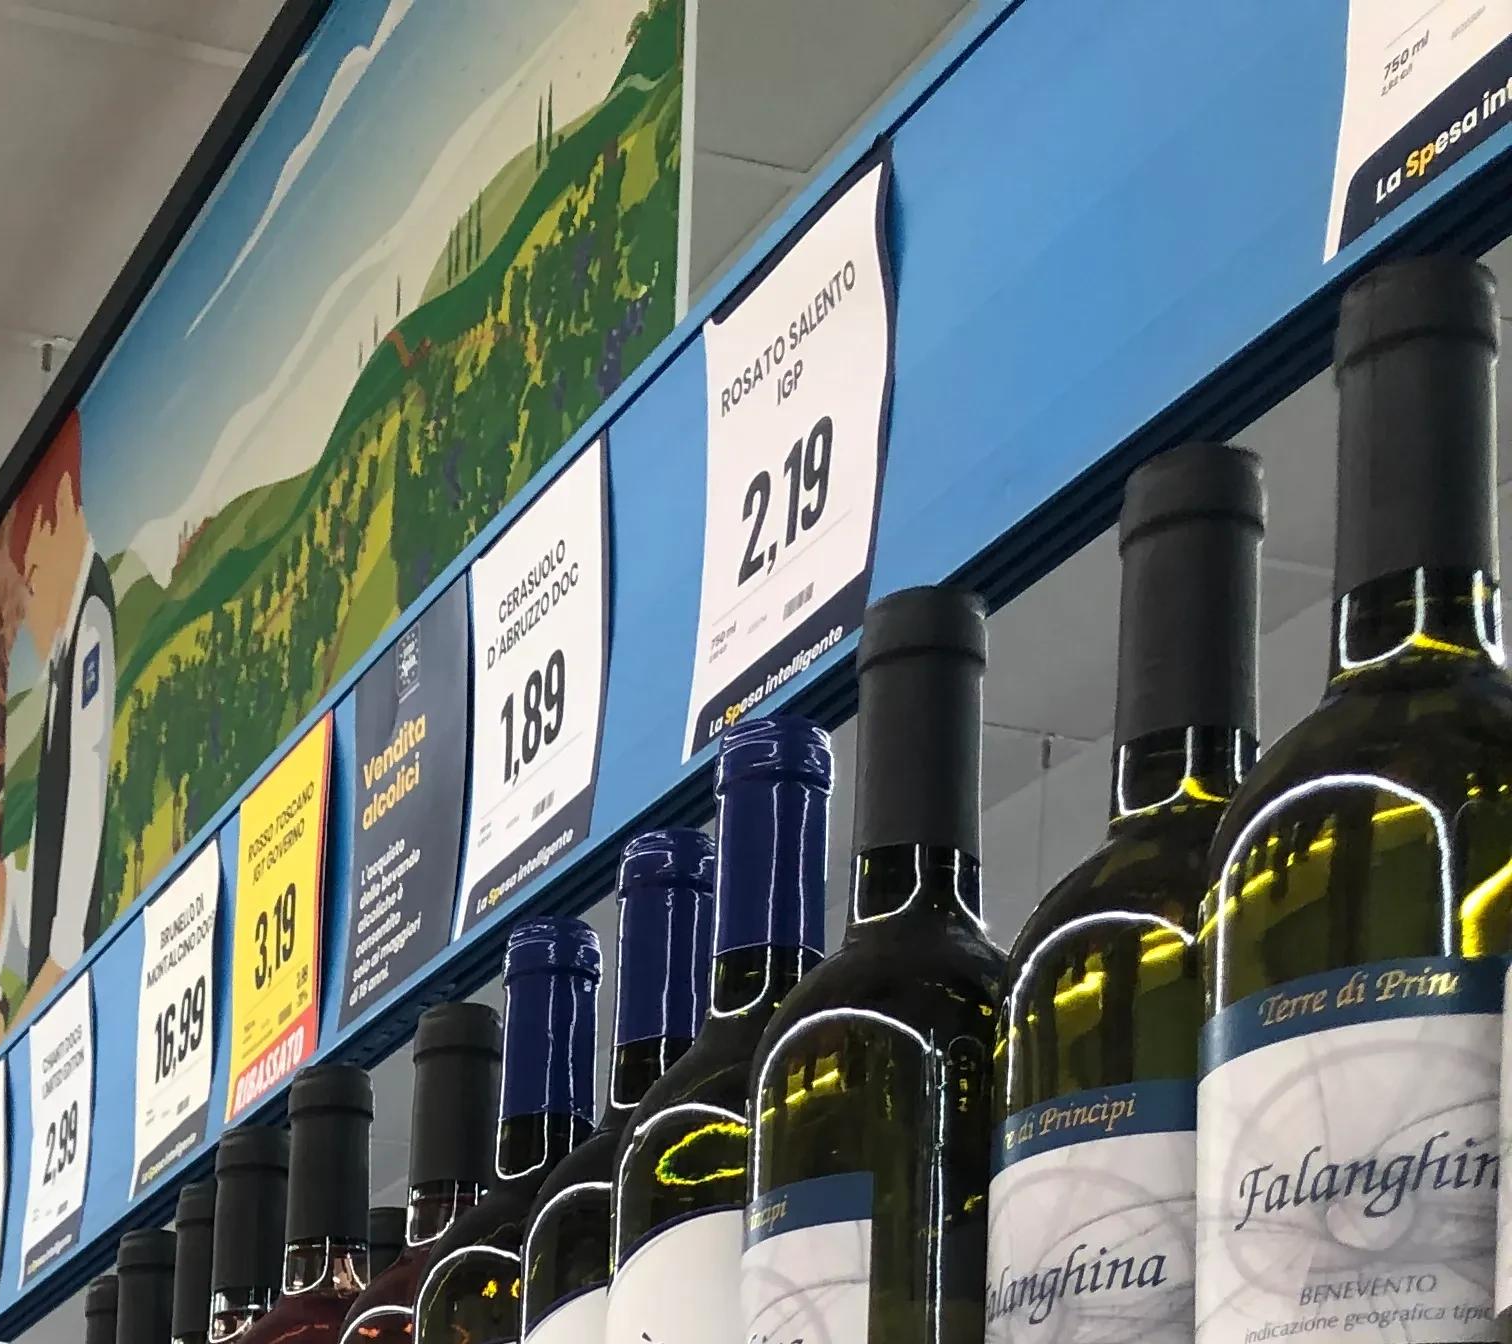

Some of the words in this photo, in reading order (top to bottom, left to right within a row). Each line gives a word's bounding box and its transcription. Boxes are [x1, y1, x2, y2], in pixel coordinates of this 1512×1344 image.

[1383, 47, 1409, 80] 750
[1411, 29, 1430, 57] ml
[1376, 167, 1402, 204] La
[721, 336, 785, 417] ROSATO
[789, 260, 855, 349] SALENTO
[777, 360, 803, 406] IGP
[738, 416, 833, 587] 2,19
[488, 592, 549, 671] D'ABRUZZO
[552, 562, 578, 606] DOC
[499, 539, 565, 623] CERASUOLO
[501, 648, 565, 786] 1,89
[709, 715, 723, 738] La
[765, 625, 843, 694] intelligente
[362, 752, 420, 830] alcolici
[363, 714, 426, 790] Vendita
[254, 883, 296, 991] 3,19
[154, 974, 206, 1084] 16,99
[1335, 971, 1369, 1010] di
[43, 1100, 78, 1187] 2,99
[1299, 1273, 1438, 1308] BENEVENTO
[1343, 1306, 1448, 1333] geografica
